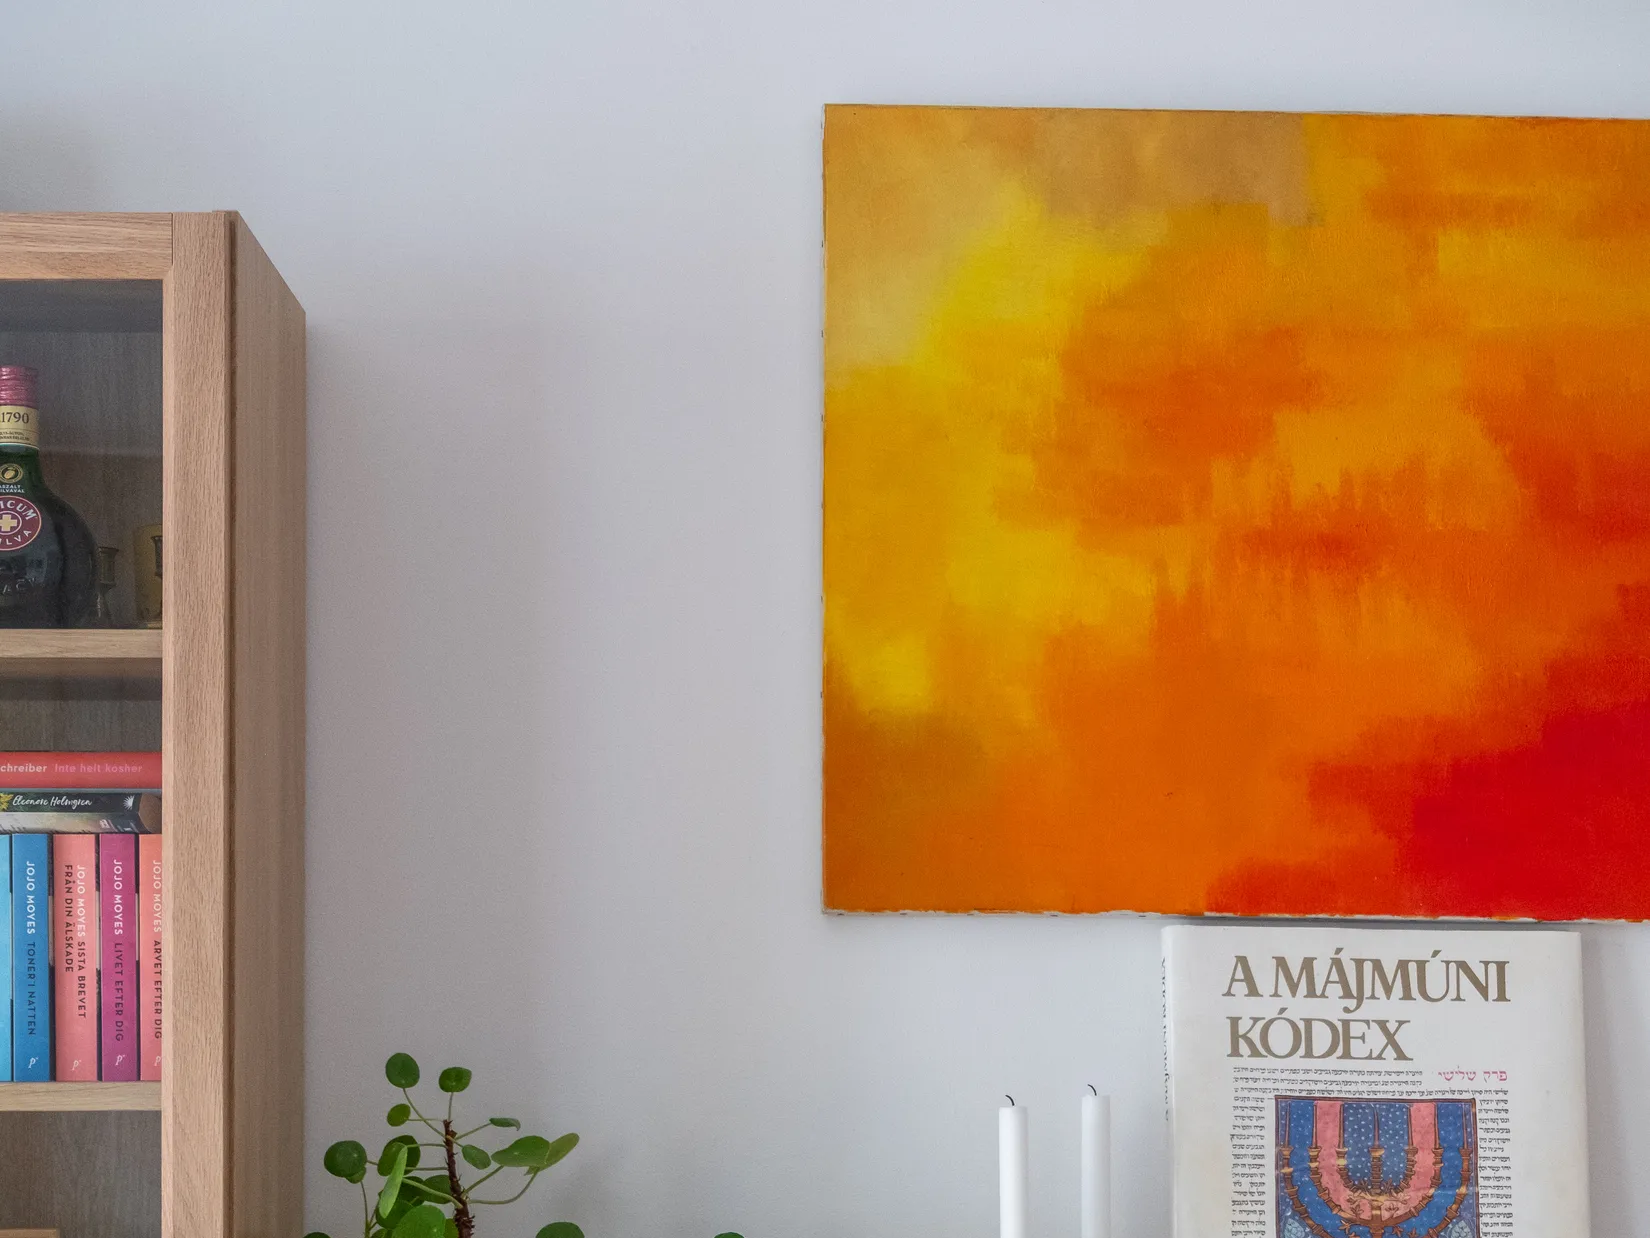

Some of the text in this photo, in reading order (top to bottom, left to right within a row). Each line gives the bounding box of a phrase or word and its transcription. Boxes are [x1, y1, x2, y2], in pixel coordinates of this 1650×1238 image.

[0, 763, 143, 773] chreiber Inte helt kosher
[50, 795, 93, 810] Holmgren
[26, 861, 35, 891] JOJO
[153, 860, 162, 889] JOJO
[26, 895, 35, 934] MOYES
[64, 864, 76, 973] FRÅN DIN ÄLSKADE
[153, 894, 162, 933] MOYES
[76, 864, 87, 1019] JOJO MOYES SISTA BREVET
[113, 860, 124, 1042] JOJO MOYES LIVET EFTER DIG
[27, 942, 36, 981] TONER
[1222, 947, 1511, 1014] A MÁJMÚNI
[28, 991, 36, 1036] NATTEN
[154, 1019, 162, 1040] DIG
[1226, 1007, 1414, 1061] KÓDEX
[1438, 1065, 1477, 1081] שלישי
[1483, 1070, 1508, 1083] פרק
